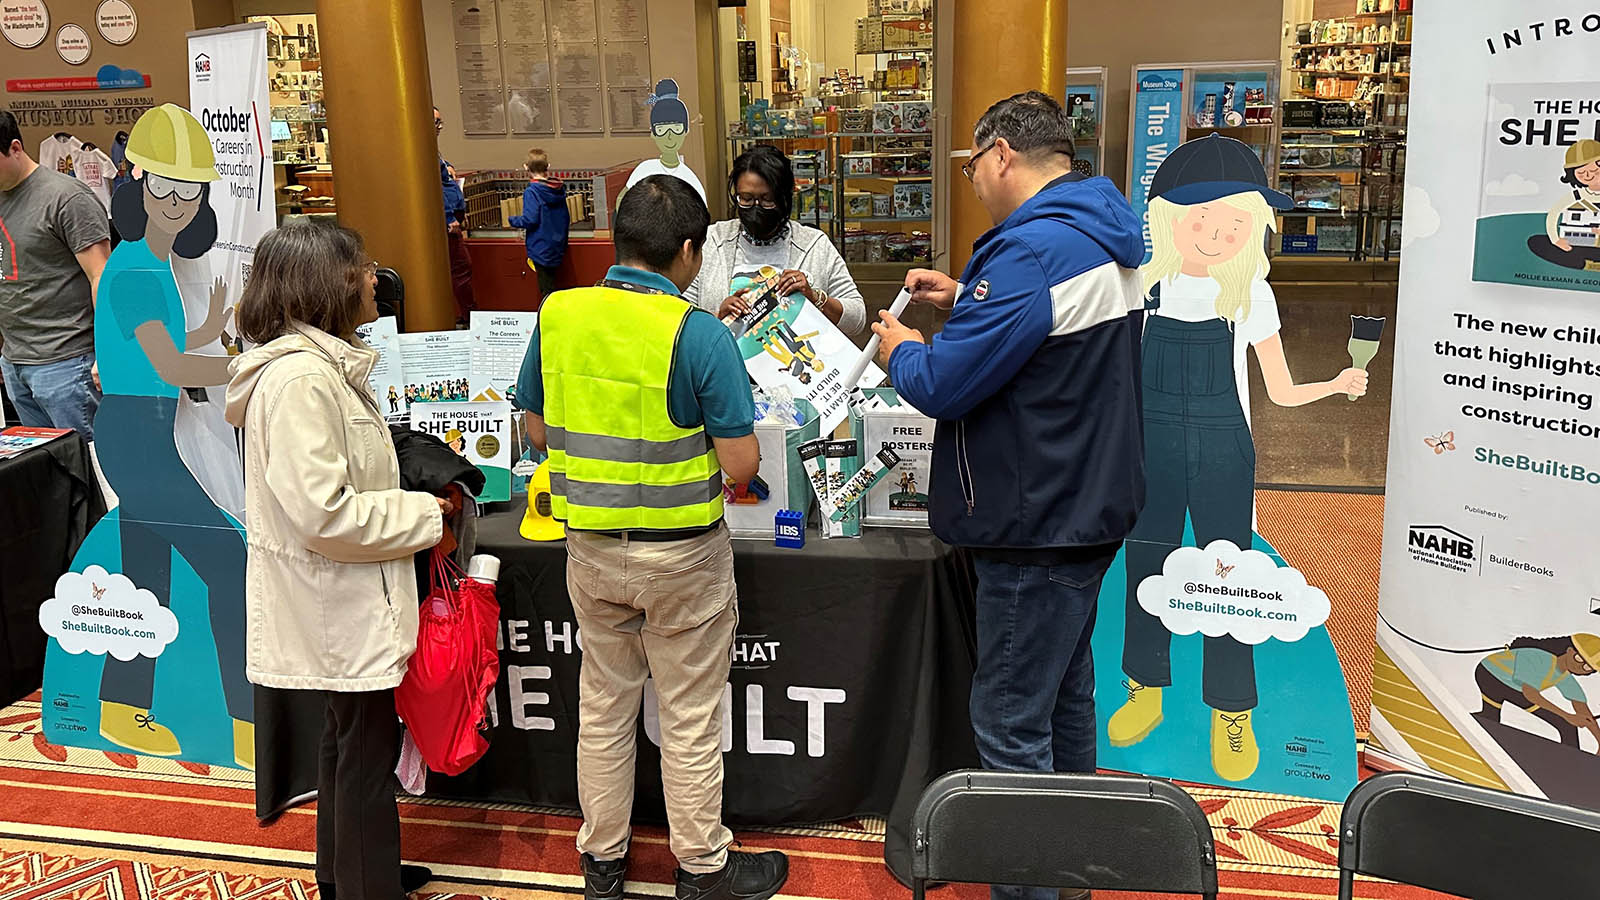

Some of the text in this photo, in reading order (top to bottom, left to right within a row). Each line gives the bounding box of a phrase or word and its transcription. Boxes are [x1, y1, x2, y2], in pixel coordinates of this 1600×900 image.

[1486, 14, 1600, 54] INTRO
[195, 60, 210, 72] NAHB
[1164, 80, 1177, 88] Shop
[104, 107, 147, 124] SHO
[1534, 100, 1572, 114] THE
[202, 106, 251, 132] October
[1147, 102, 1170, 136] The
[1499, 118, 1580, 146] SHE
[216, 138, 252, 155] Careers in
[214, 160, 254, 177] nstruction
[230, 182, 254, 199] Month
[1514, 272, 1541, 281] MOLLIE
[1542, 275, 1573, 284] ELKMAN
[1454, 313, 1600, 344] The new chil
[1434, 341, 1483, 360] that
[807, 368, 840, 401] BUILD IT!
[820, 382, 842, 402] BE IT.
[1443, 373, 1592, 410] and inspiring
[418, 420, 503, 433] SHE BUILT
[893, 427, 922, 435] FREE
[882, 442, 934, 450] POSTERS
[1464, 505, 1508, 520] Published by:
[780, 525, 798, 536] IBS
[1409, 530, 1474, 560] NAHB
[1408, 547, 1472, 568] National Association
[1421, 556, 1439, 566] Home
[1440, 562, 1467, 572] Builders
[1489, 554, 1554, 577] BuilderBooks
[1184, 582, 1283, 601] @SheBuiltBook
[71, 605, 144, 621] @SheBuiltBook
[1169, 599, 1297, 622] SheBuiltBook.com
[61, 620, 156, 639] SheBuiltBook.com
[731, 642, 780, 663] HAT
[55, 722, 87, 732] grouptwo
[1284, 769, 1330, 780] grouptwo
